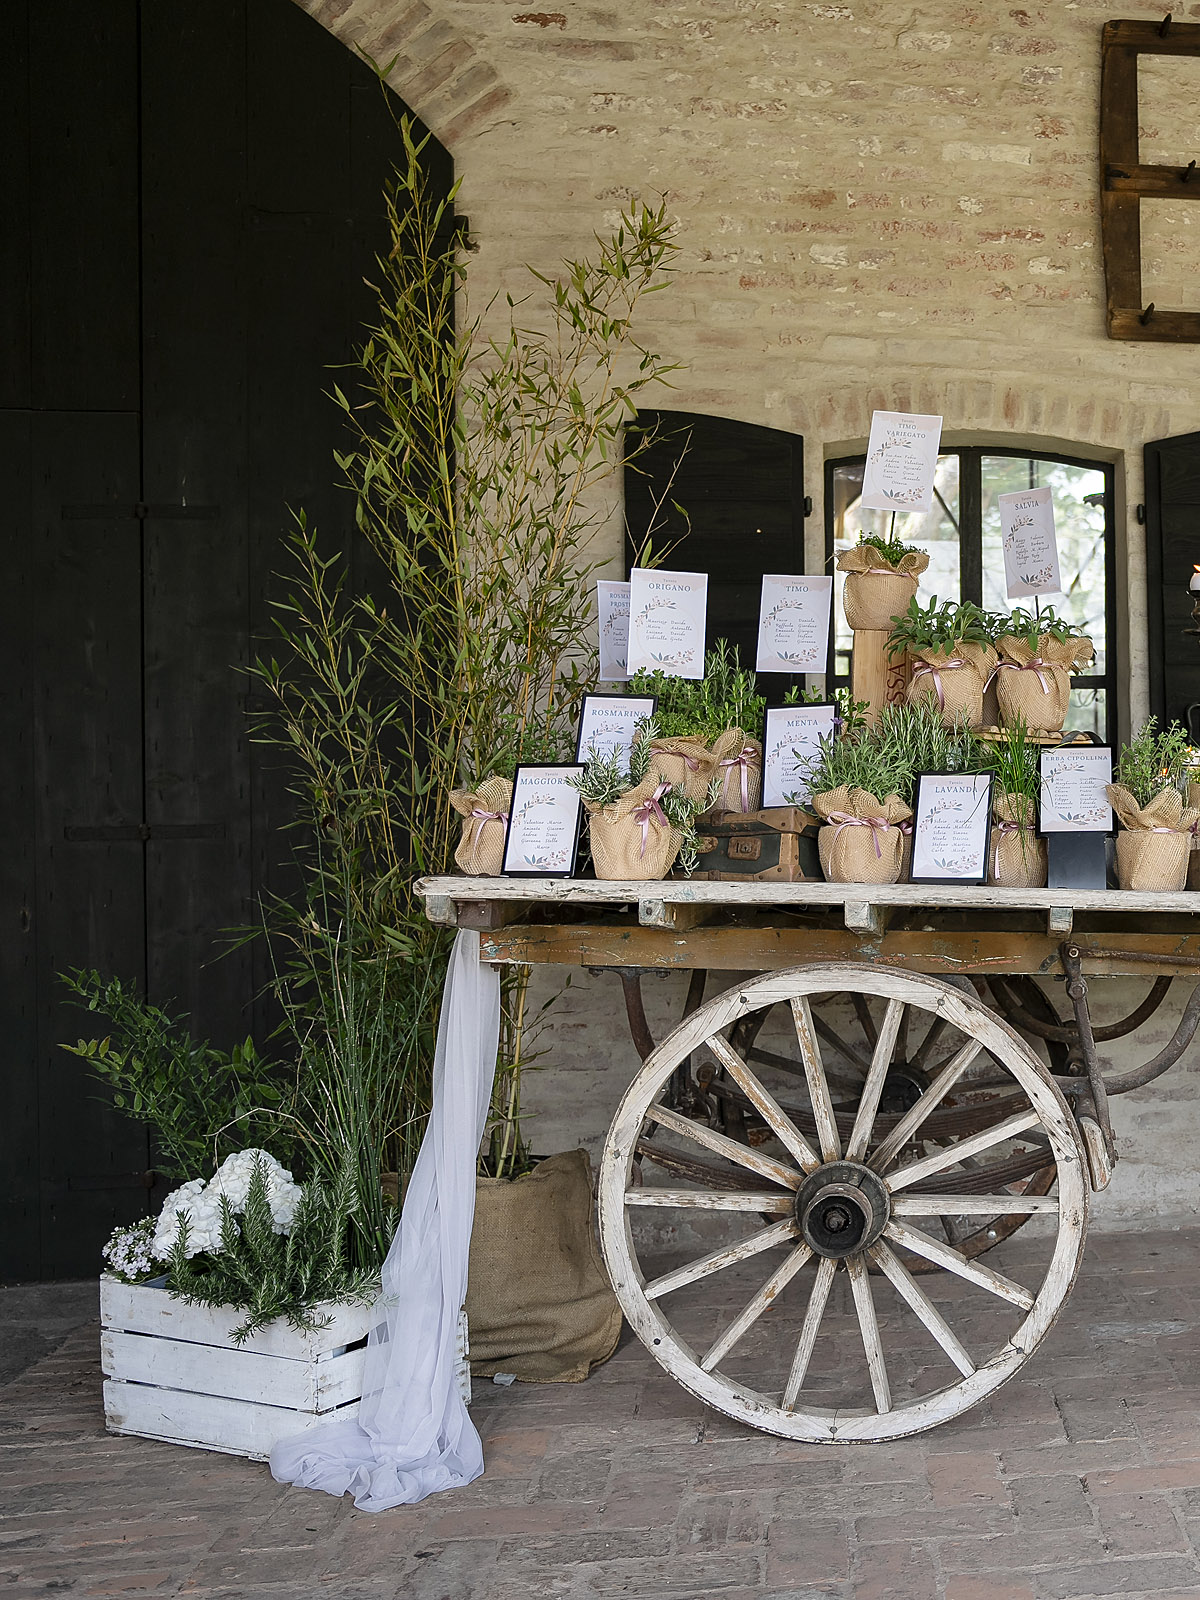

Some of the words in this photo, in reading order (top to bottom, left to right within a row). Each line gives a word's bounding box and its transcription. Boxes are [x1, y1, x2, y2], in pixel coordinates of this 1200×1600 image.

[886, 430, 926, 438] VARIEGATO
[1014, 500, 1040, 510] SALVIA
[648, 583, 691, 592] ORIGANO
